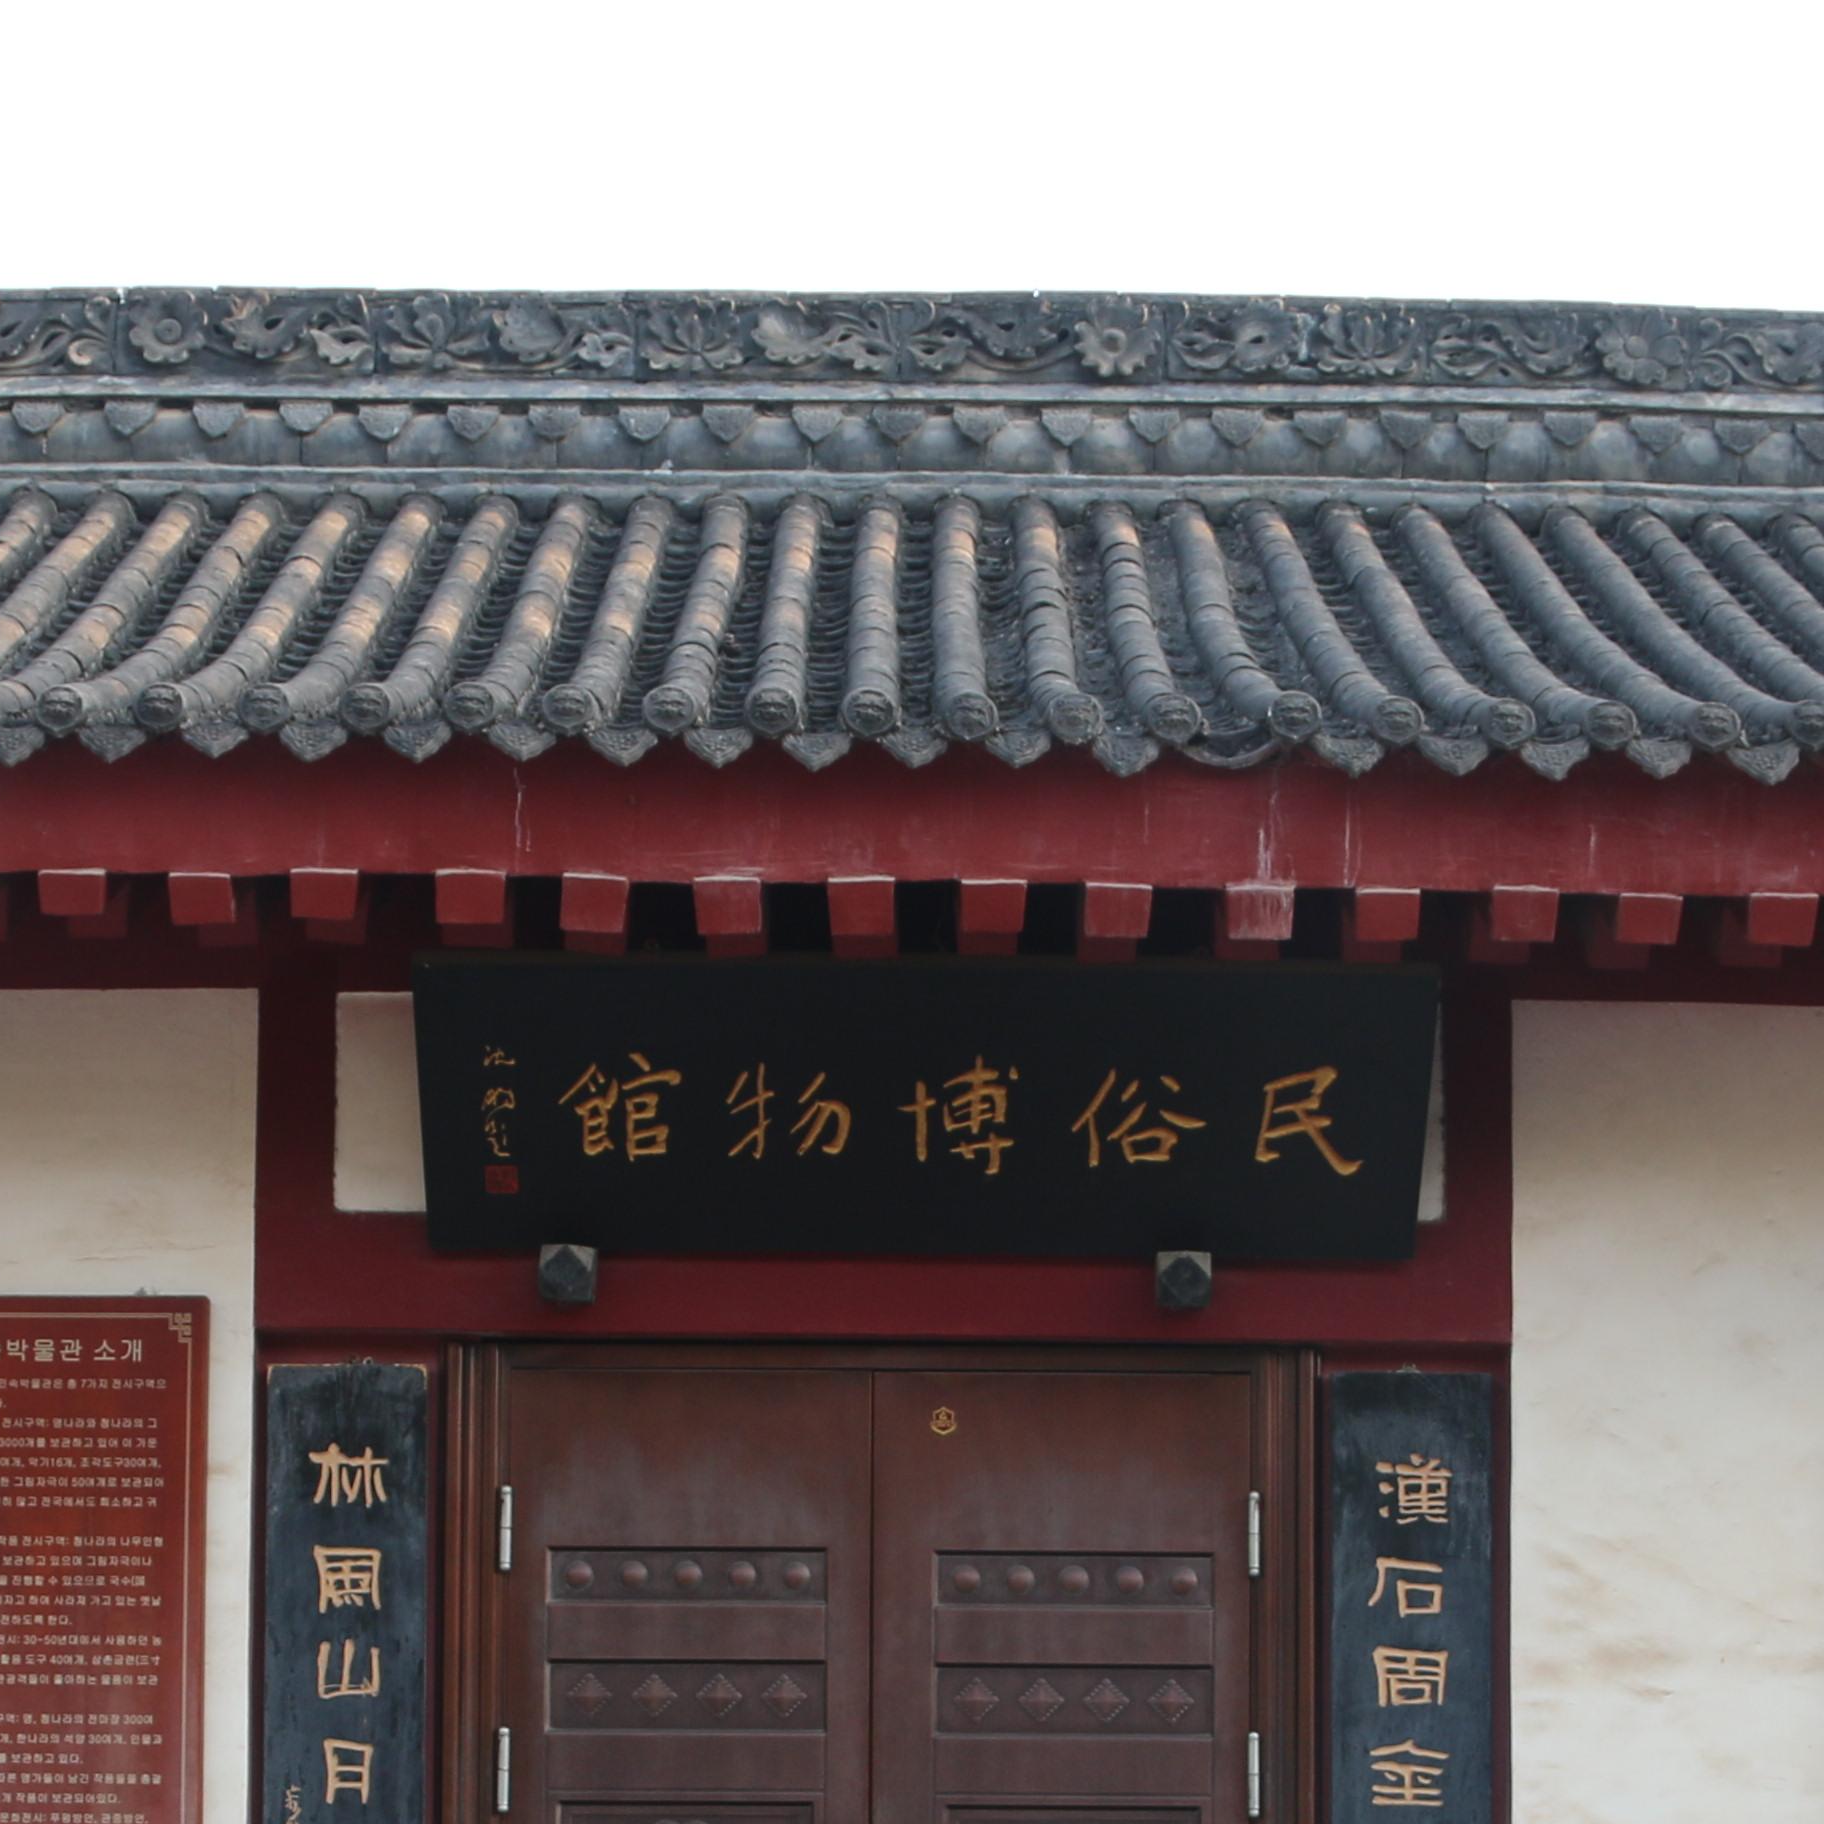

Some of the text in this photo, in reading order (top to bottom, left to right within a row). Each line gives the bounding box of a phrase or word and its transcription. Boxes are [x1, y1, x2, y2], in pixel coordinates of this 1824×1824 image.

[558, 1052, 1364, 1175] 民俗博物館
[93, 1338, 143, 1362] 소개
